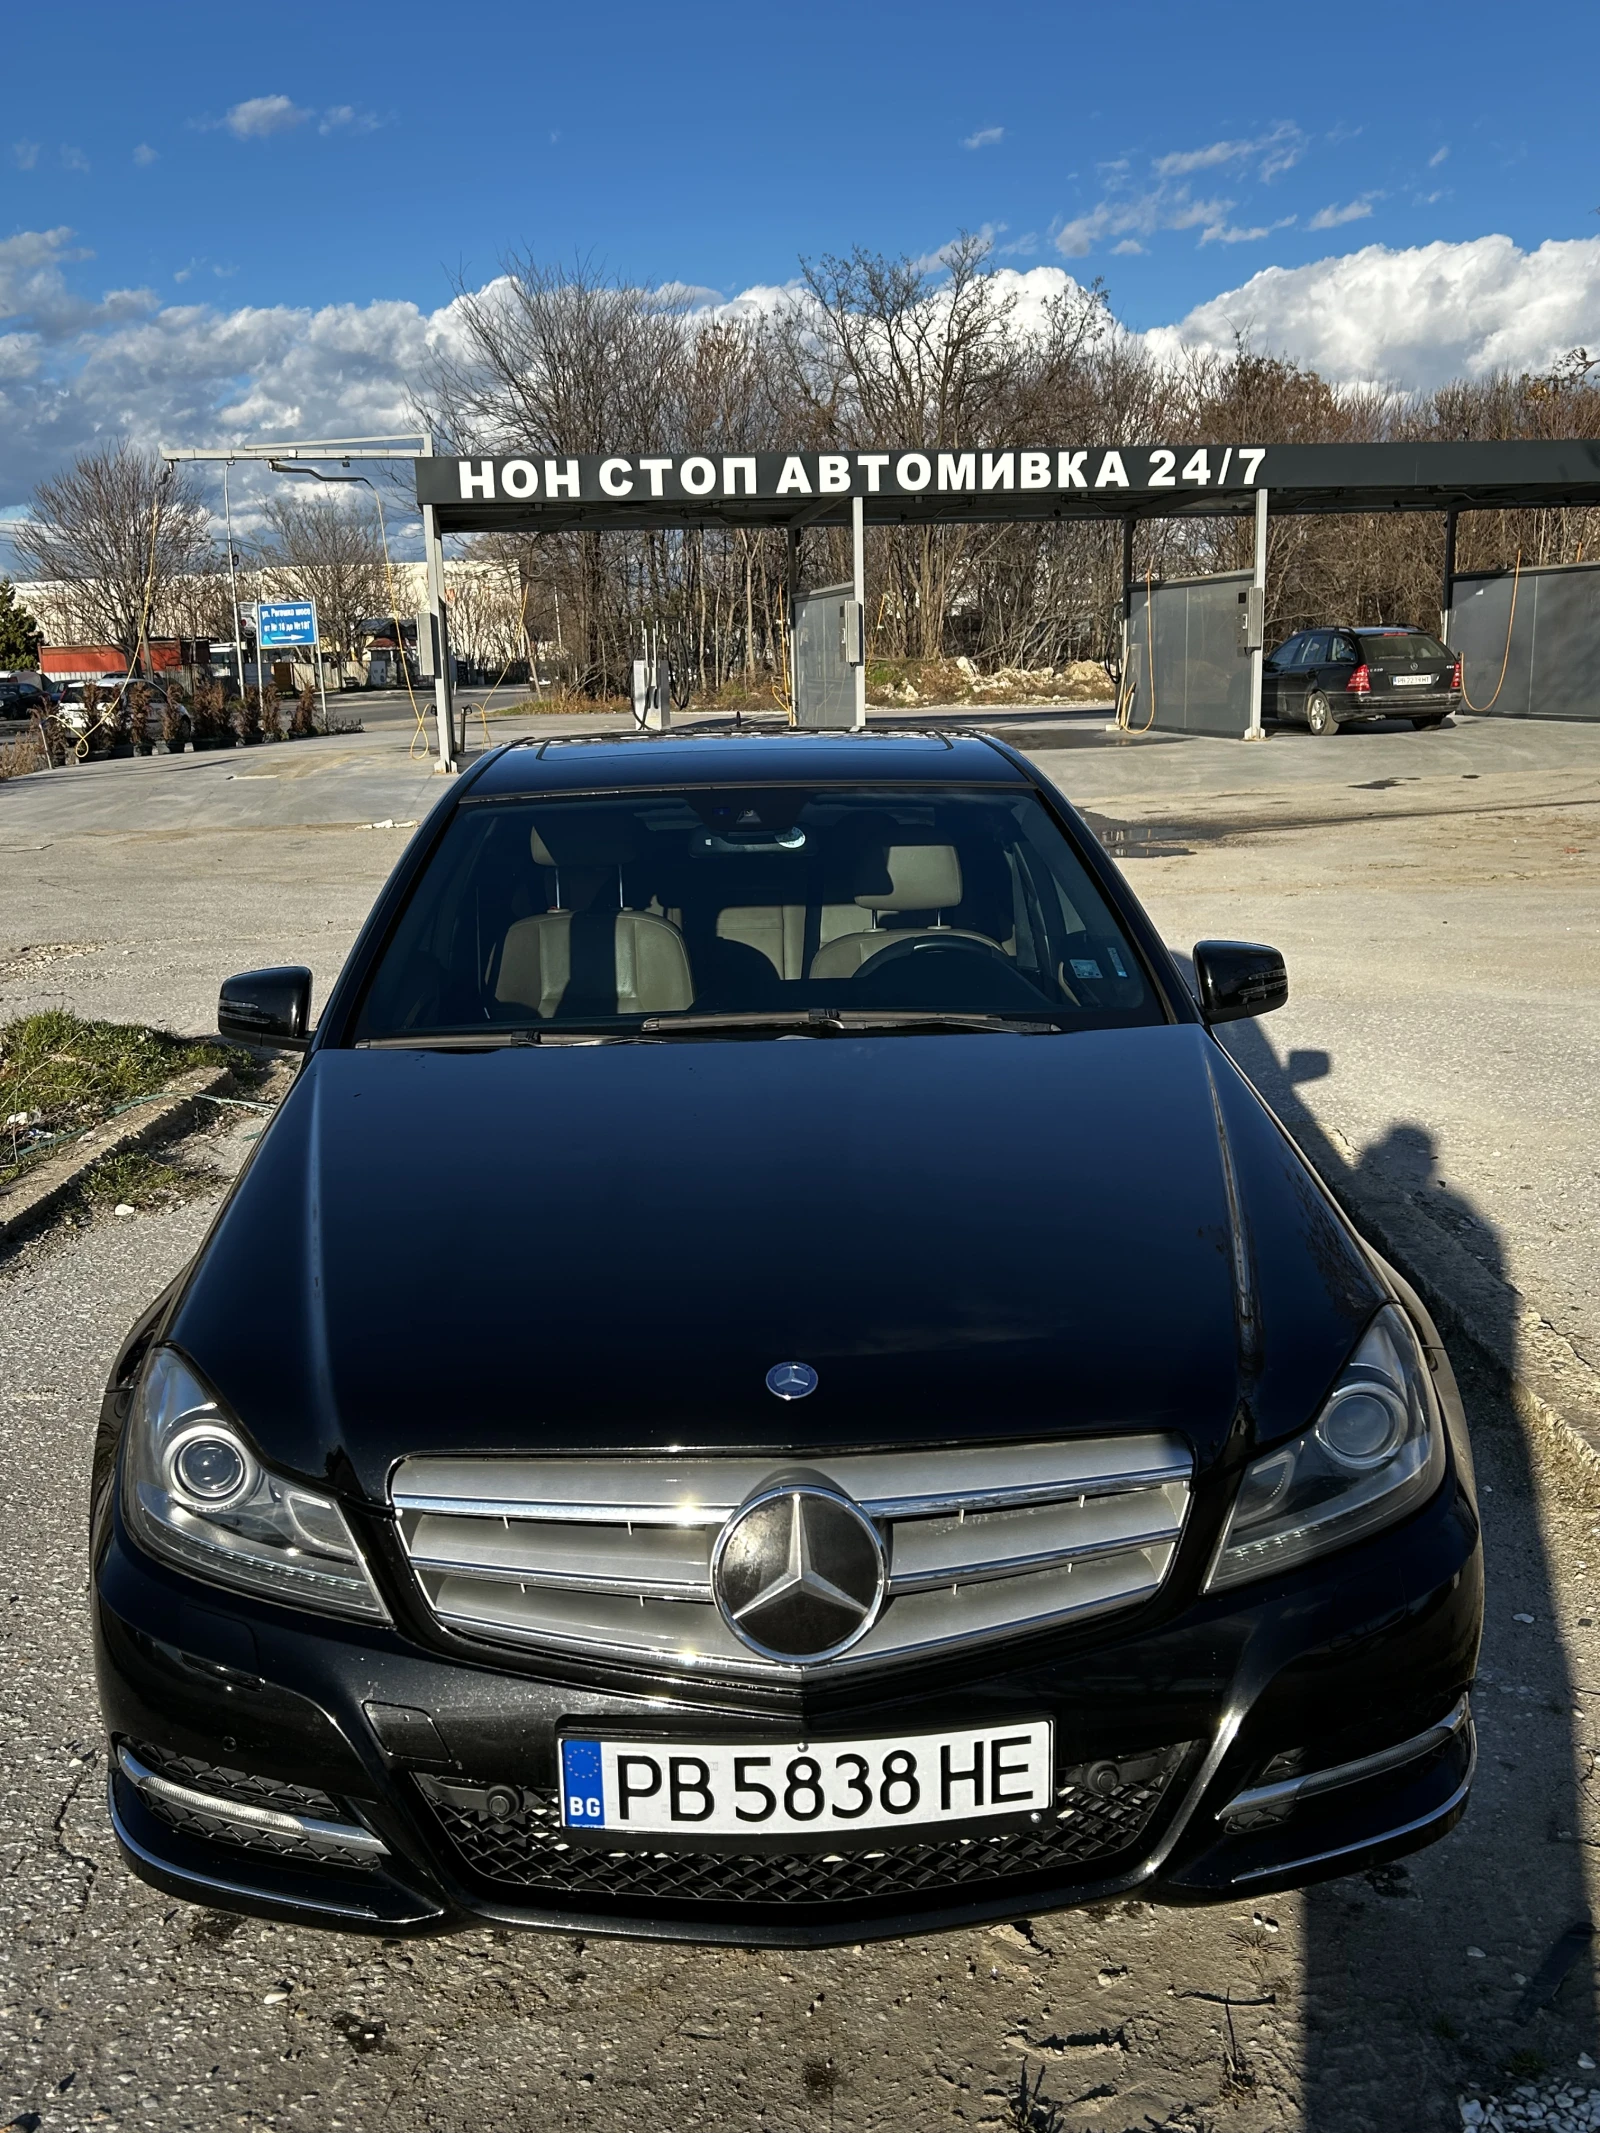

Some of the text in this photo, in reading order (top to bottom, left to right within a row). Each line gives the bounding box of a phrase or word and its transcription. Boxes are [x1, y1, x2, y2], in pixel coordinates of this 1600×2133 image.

[458, 447, 1267, 499] НОН СТОП АВТОМИВКА 24/7
[616, 1735, 1034, 1822] PB 5838 HE
[569, 1796, 601, 1818] BG
